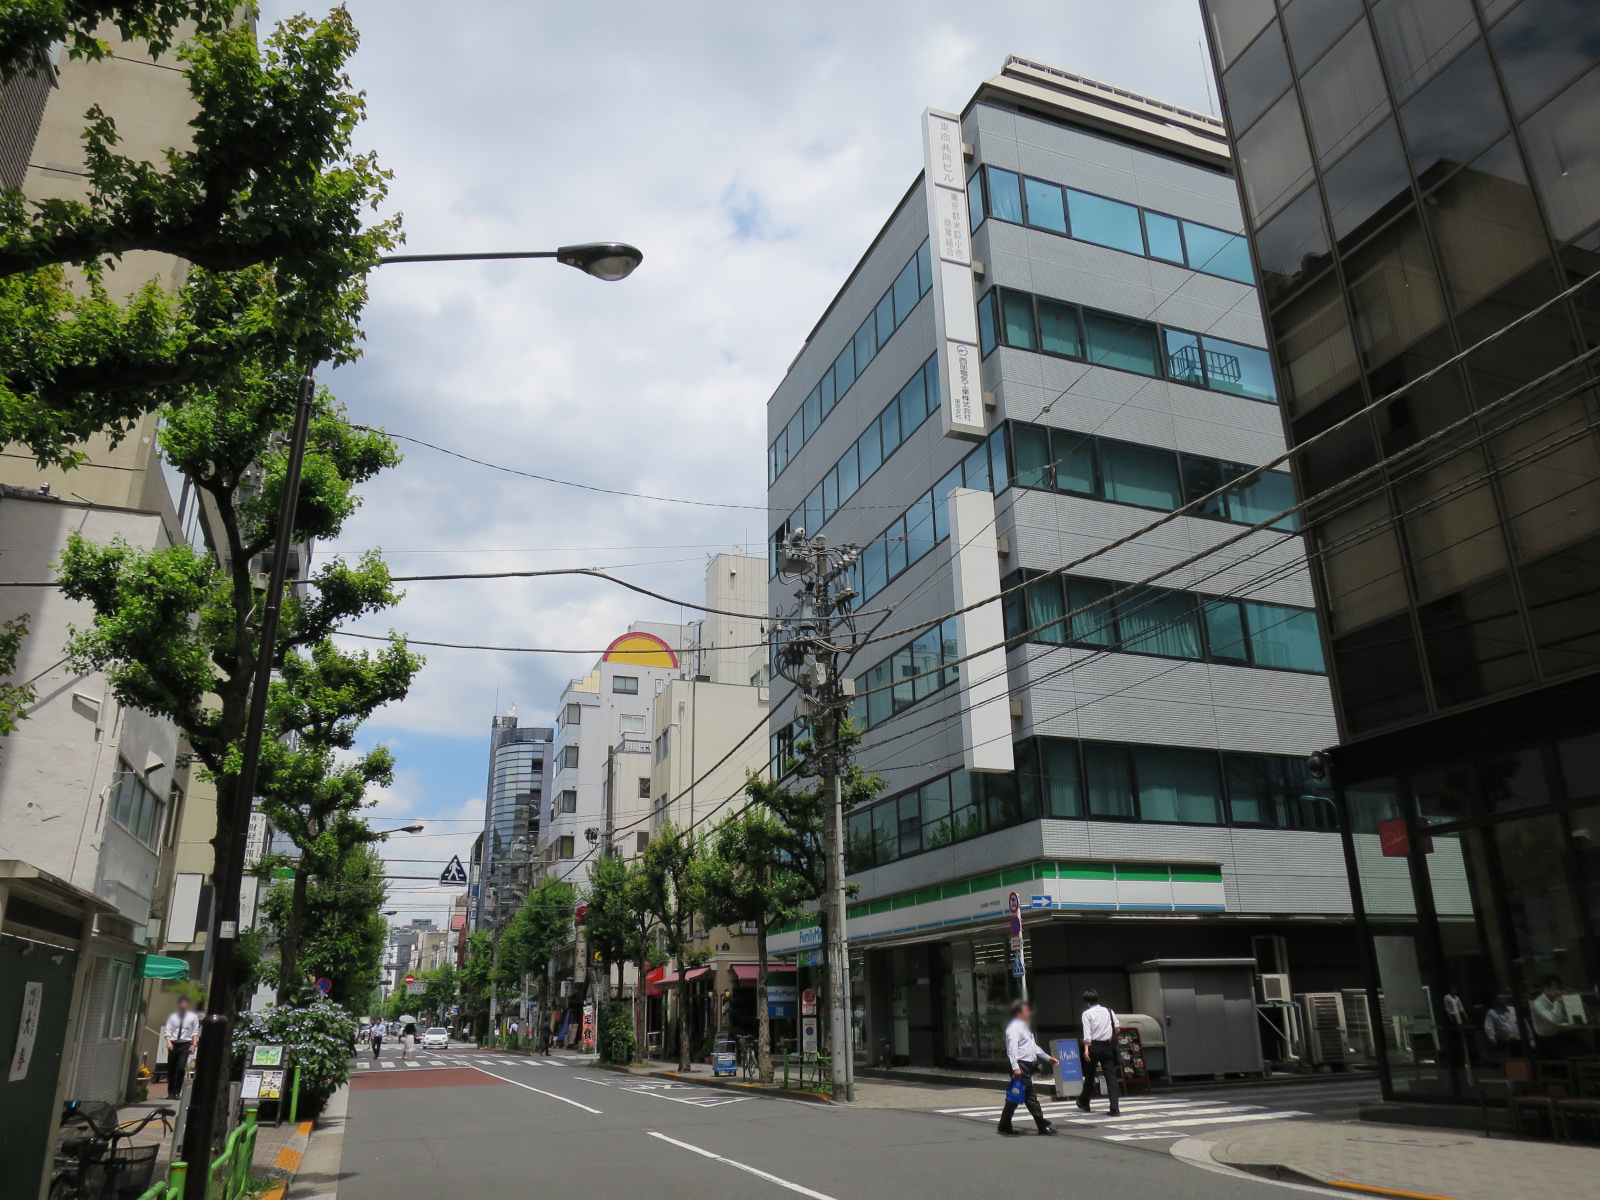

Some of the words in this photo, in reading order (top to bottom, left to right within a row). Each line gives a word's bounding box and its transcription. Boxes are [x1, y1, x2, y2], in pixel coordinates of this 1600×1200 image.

[940, 122, 955, 182] 東商共同ビル
[944, 218, 954, 257] 商業組合
[799, 927, 823, 944] FamilyMa
[767, 990, 796, 998] amilyMart
[583, 1014, 592, 1040] 定食
